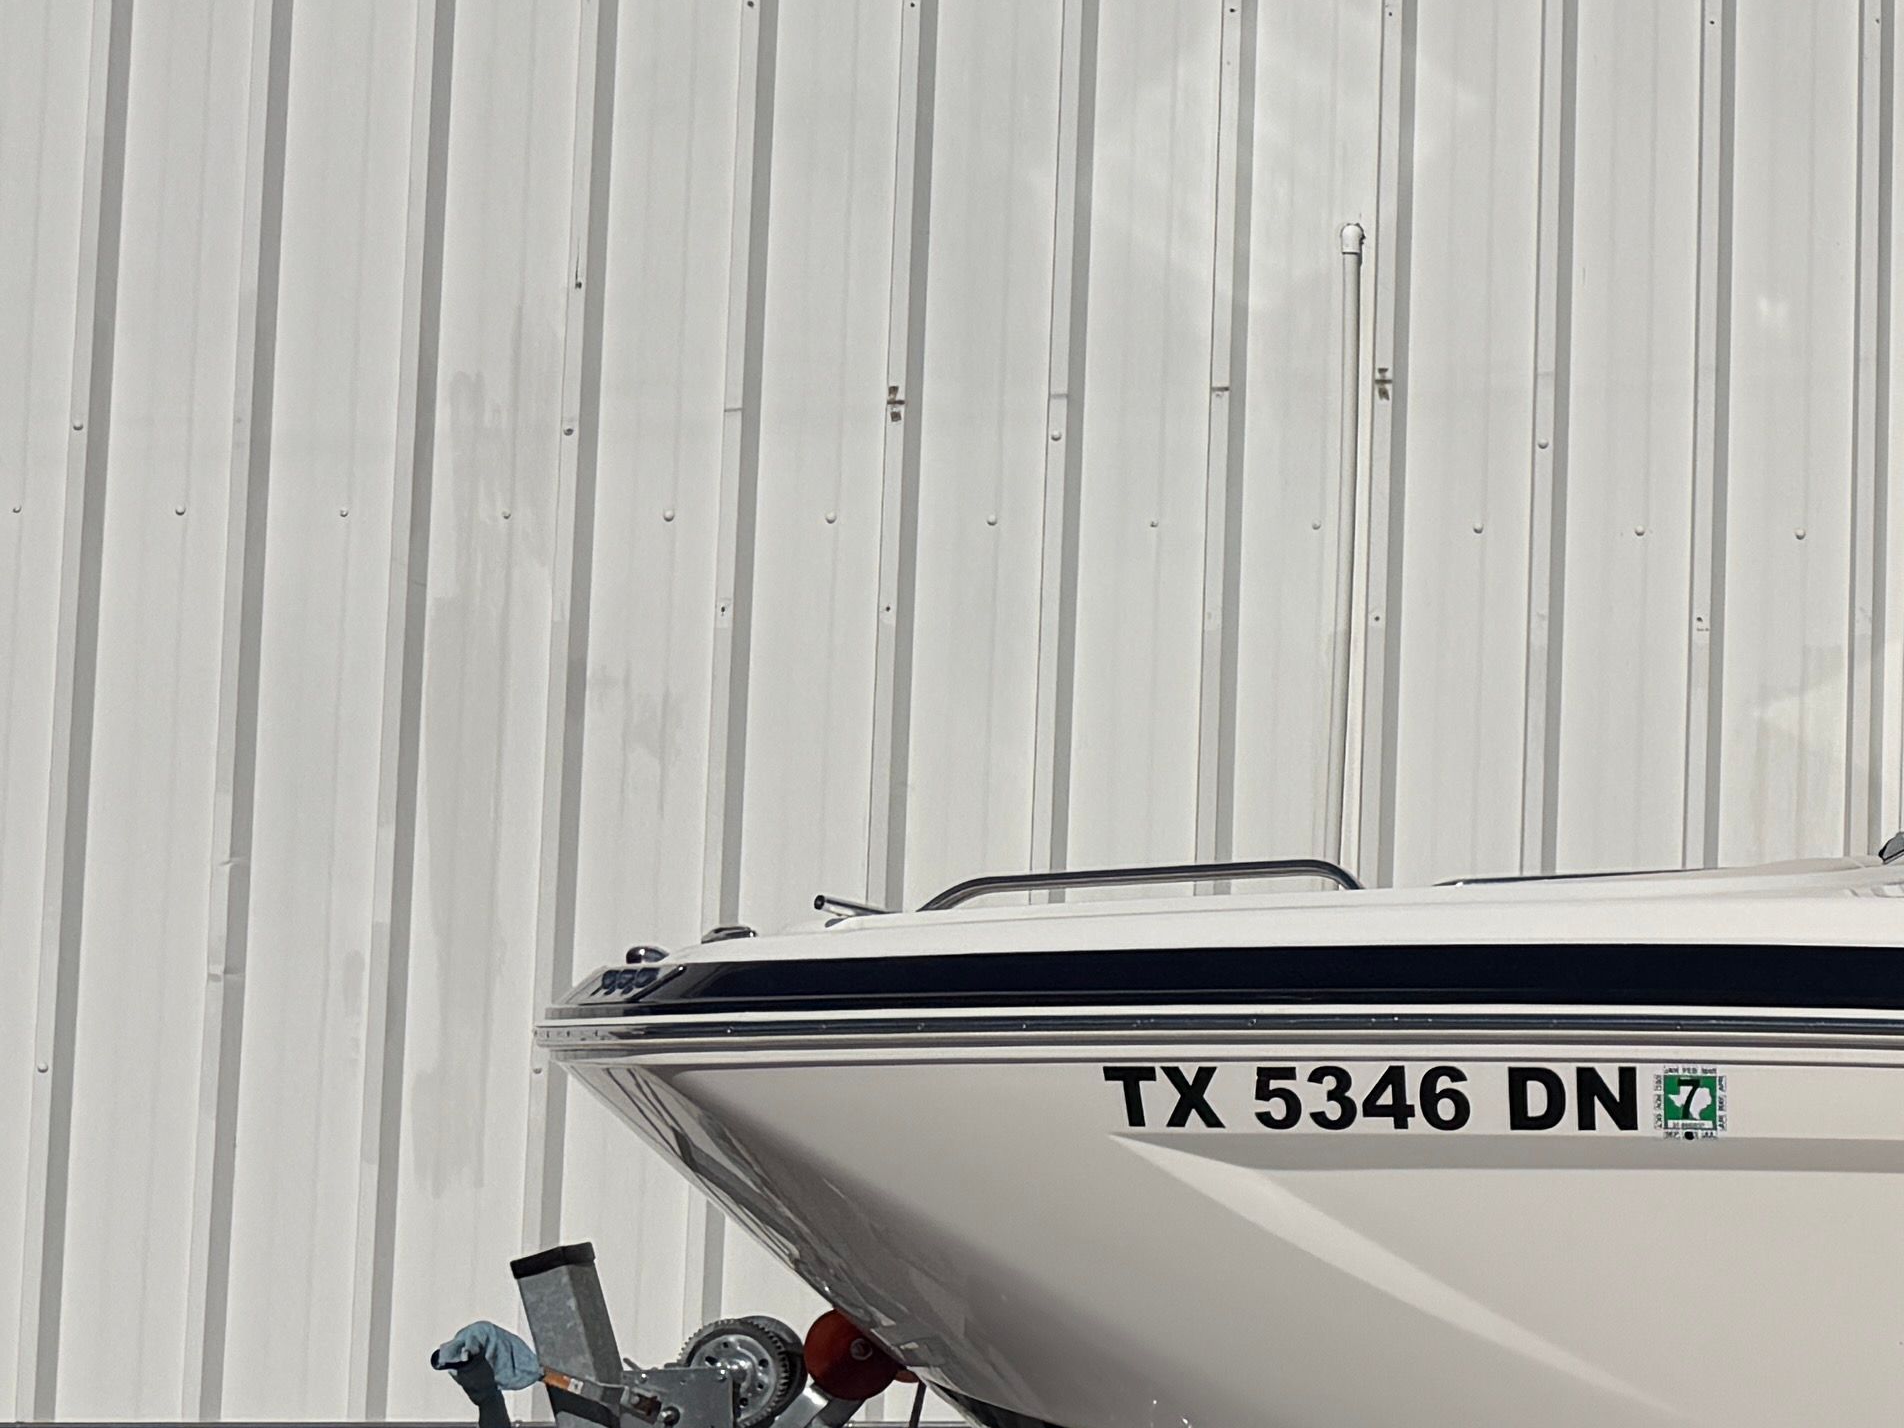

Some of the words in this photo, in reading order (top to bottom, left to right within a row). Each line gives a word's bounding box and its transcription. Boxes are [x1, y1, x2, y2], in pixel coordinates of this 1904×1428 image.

[1103, 1065, 1226, 1129] TX
[1254, 1065, 1471, 1131] 5346
[1508, 1065, 1638, 1132] DN
[1677, 1078, 1701, 1120] 7
